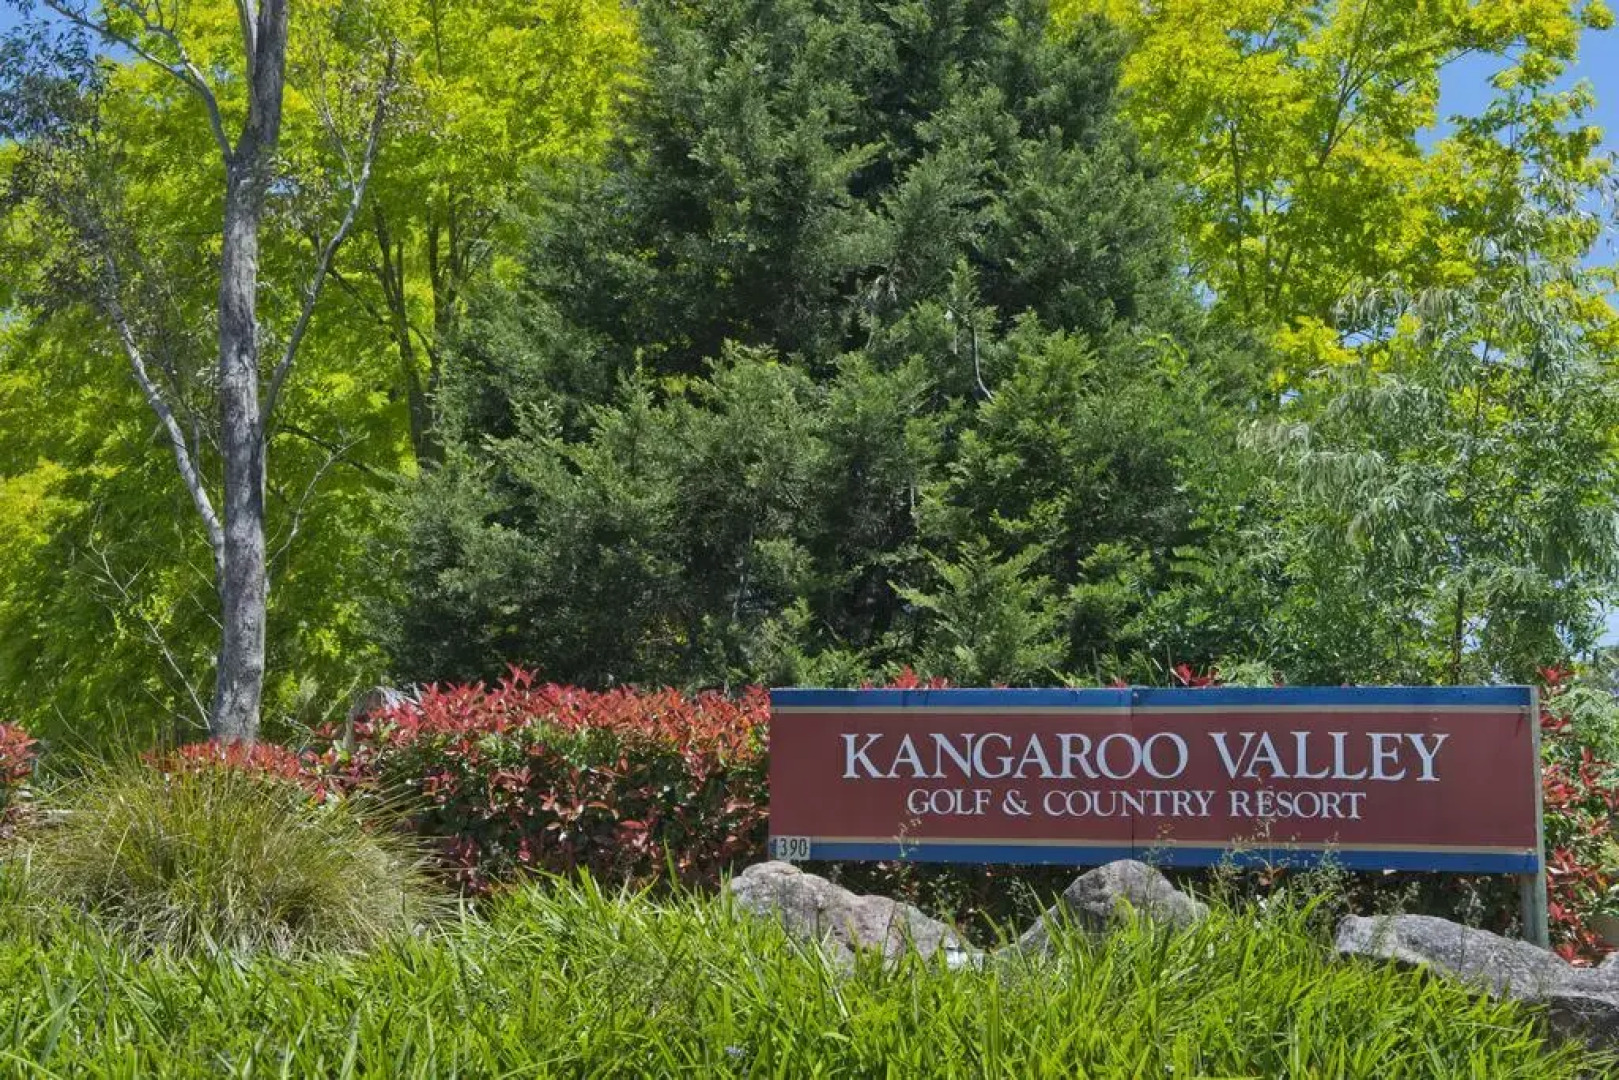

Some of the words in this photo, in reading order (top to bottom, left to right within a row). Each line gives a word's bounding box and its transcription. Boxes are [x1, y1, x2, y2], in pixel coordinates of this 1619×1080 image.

[841, 732, 1188, 780] KANGAROO
[1208, 731, 1450, 781] VALLEY
[907, 788, 992, 815] GOLF
[1002, 789, 1031, 815] &
[1043, 790, 1215, 817] COUNTRY
[1228, 790, 1366, 819] RESORT
